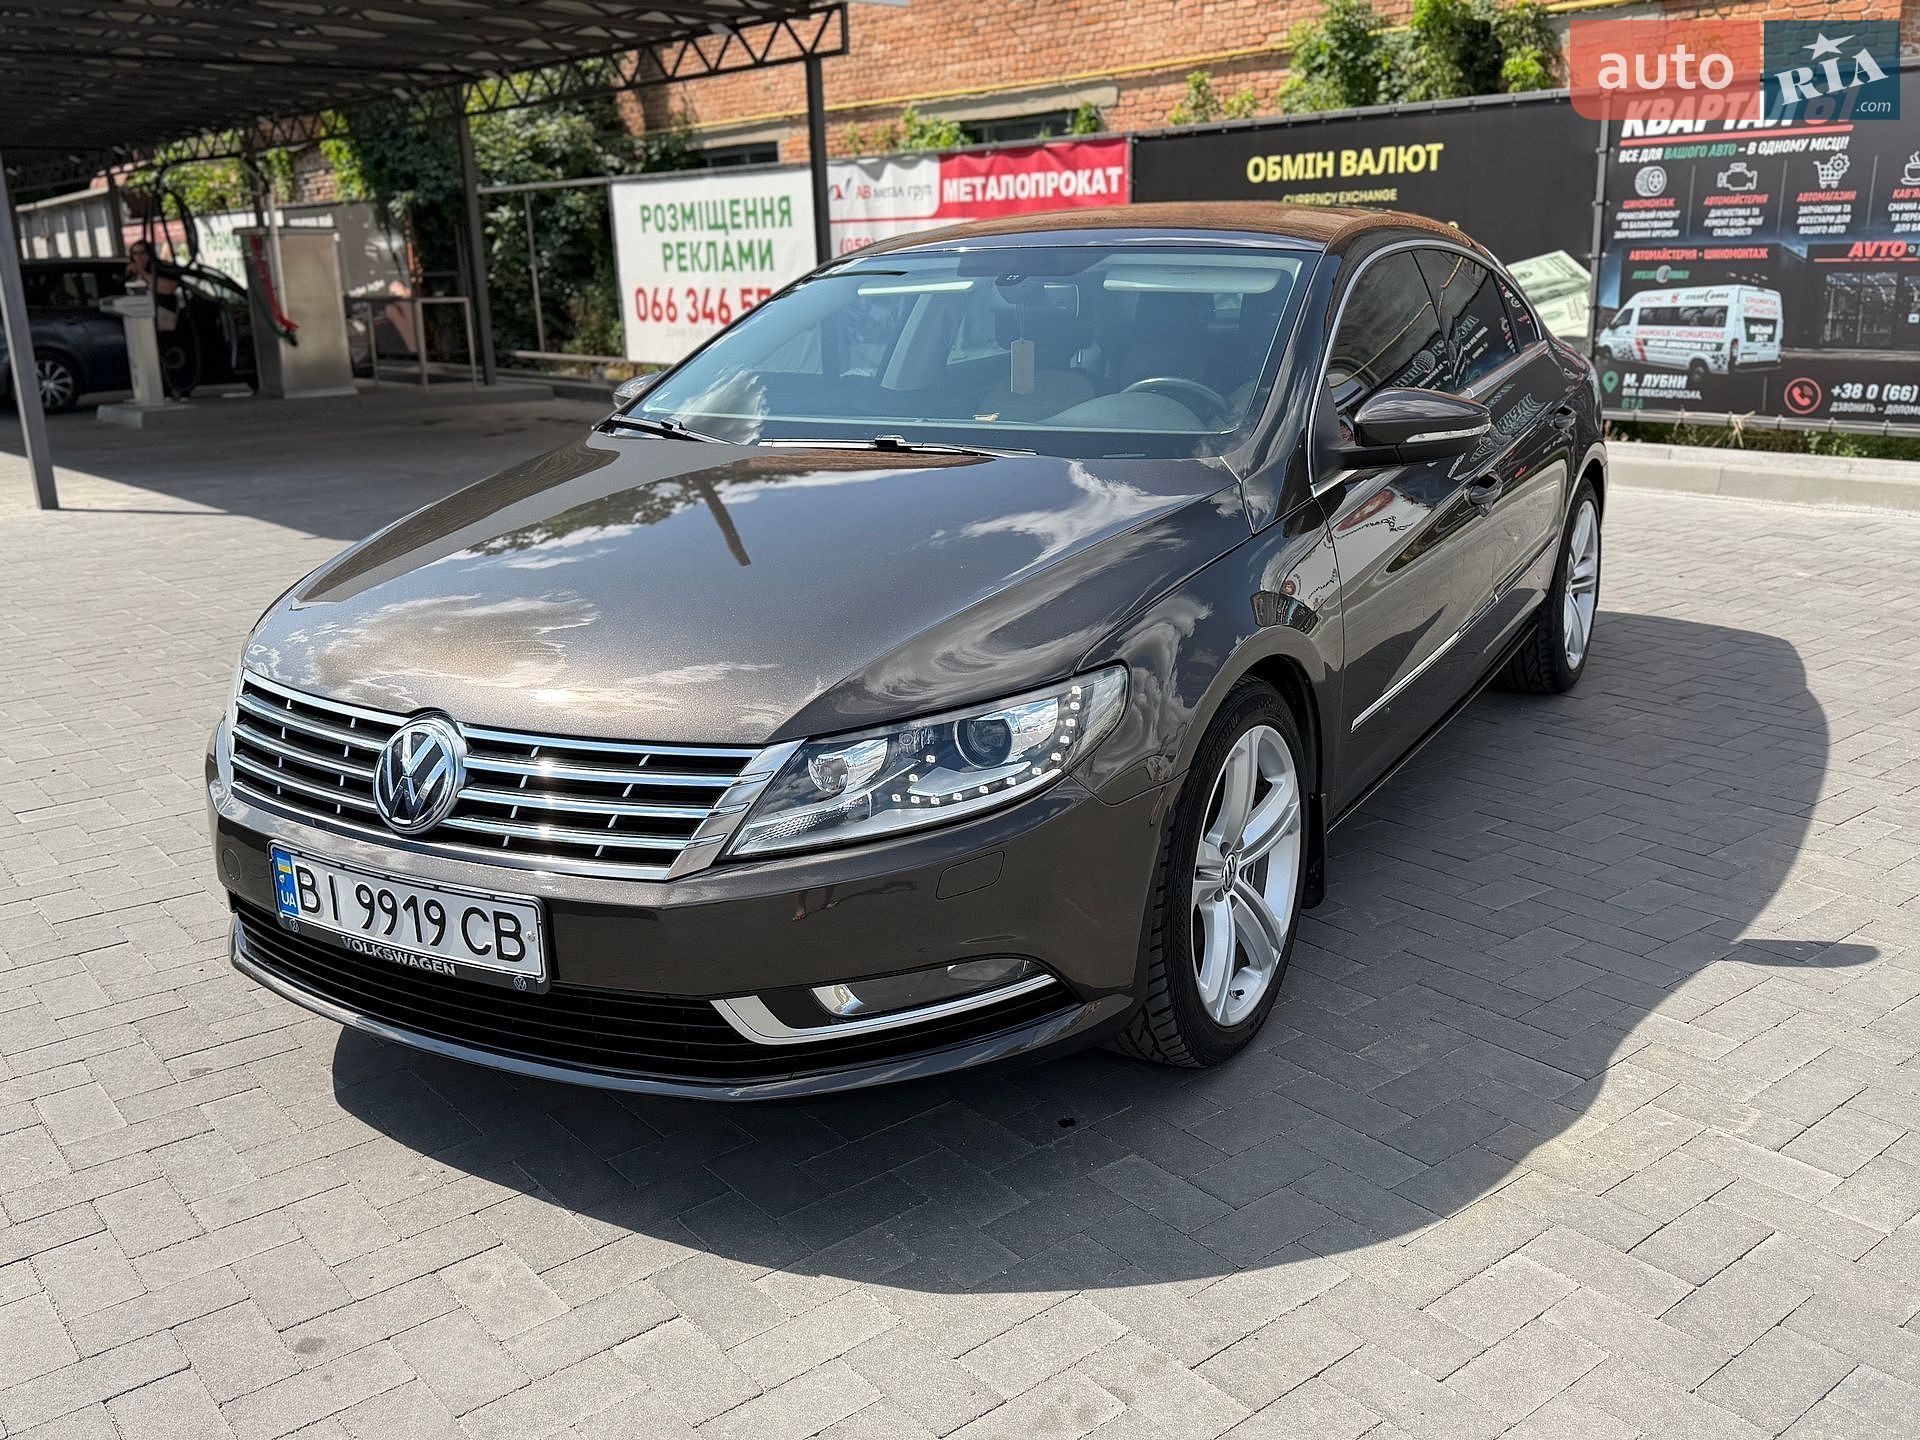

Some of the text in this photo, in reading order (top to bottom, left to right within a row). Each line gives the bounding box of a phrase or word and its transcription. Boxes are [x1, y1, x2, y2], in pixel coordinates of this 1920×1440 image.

[1621, 90, 1797, 137] КВАРТАЛ
[1246, 142, 1445, 184] ОБМІН ВАЛЮТ
[1619, 149, 1640, 163] ВСЕ
[1639, 148, 1662, 163] ДЛЯ
[1663, 145, 1707, 160] ВАШОГО
[1708, 144, 1736, 157] АВТО
[1746, 142, 1757, 155] В
[1758, 138, 1809, 155] ОДНОМУ
[943, 166, 1124, 204] МЕТАЛОПРОКАТ
[1281, 188, 1398, 206] CURRENCY EXCHANGE
[640, 195, 793, 235] РОЗМІЩЕННЯ
[661, 239, 774, 272] РЕКЛАМИ
[635, 287, 678, 323] 066
[686, 287, 732, 325] 346
[1641, 373, 1689, 389] ЛУБНИ
[1831, 382, 1919, 403] +38 0 (66)
[280, 888, 298, 909] UA
[295, 863, 527, 963] BI 9919 CB
[341, 935, 458, 977] VOLKSWAGEN
